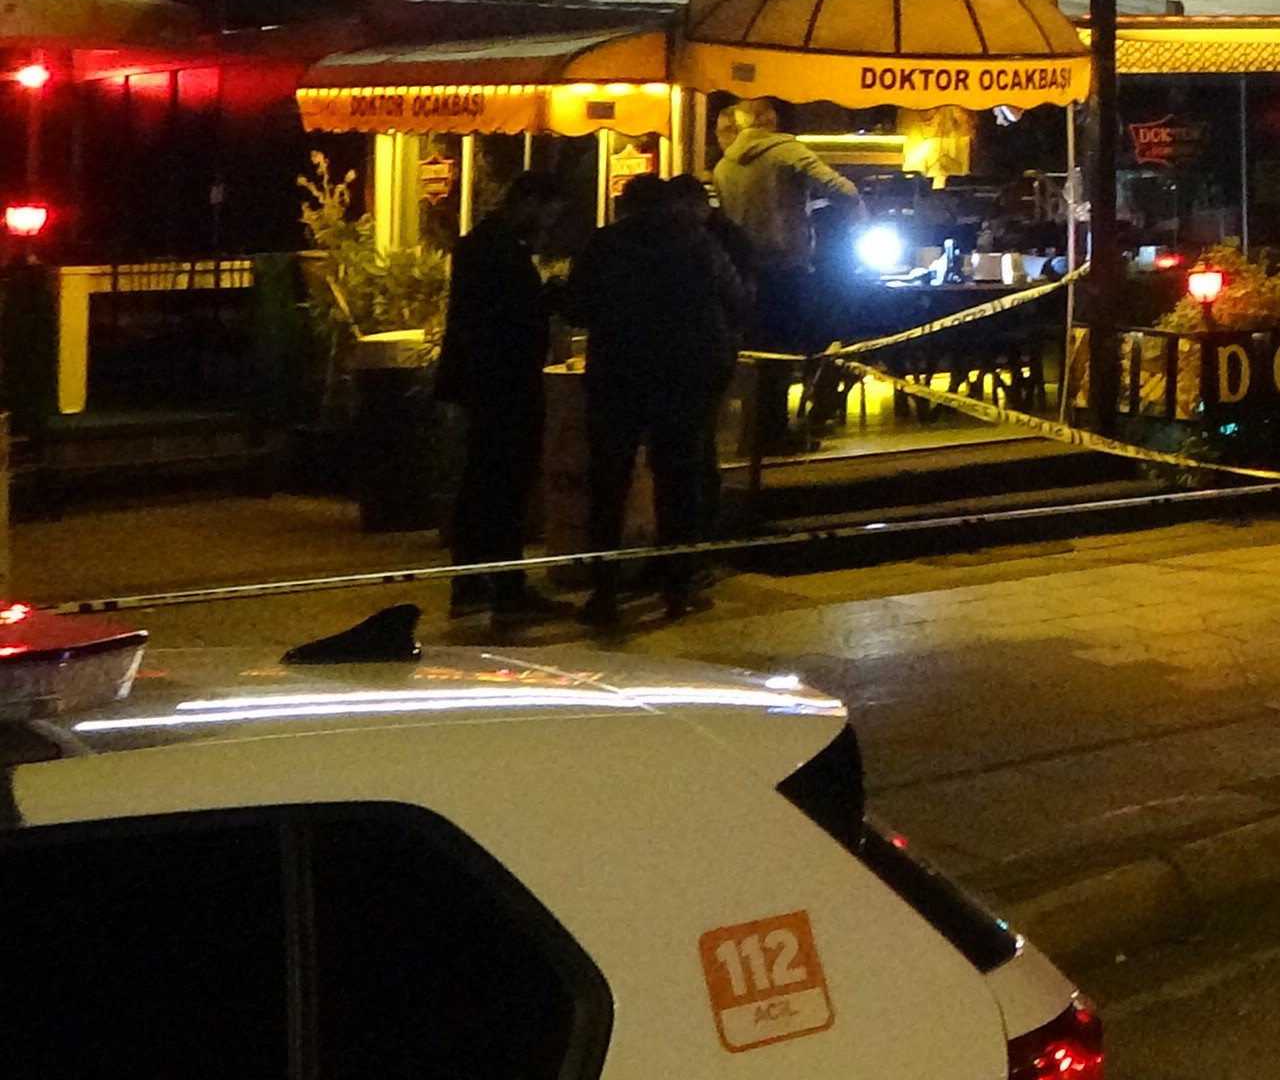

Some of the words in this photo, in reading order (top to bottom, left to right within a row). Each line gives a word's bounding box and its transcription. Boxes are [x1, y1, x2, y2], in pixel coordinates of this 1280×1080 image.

[861, 67, 969, 91] DOKTOR
[979, 67, 1072, 94] OCAKBAŞI
[714, 927, 809, 997] 112
